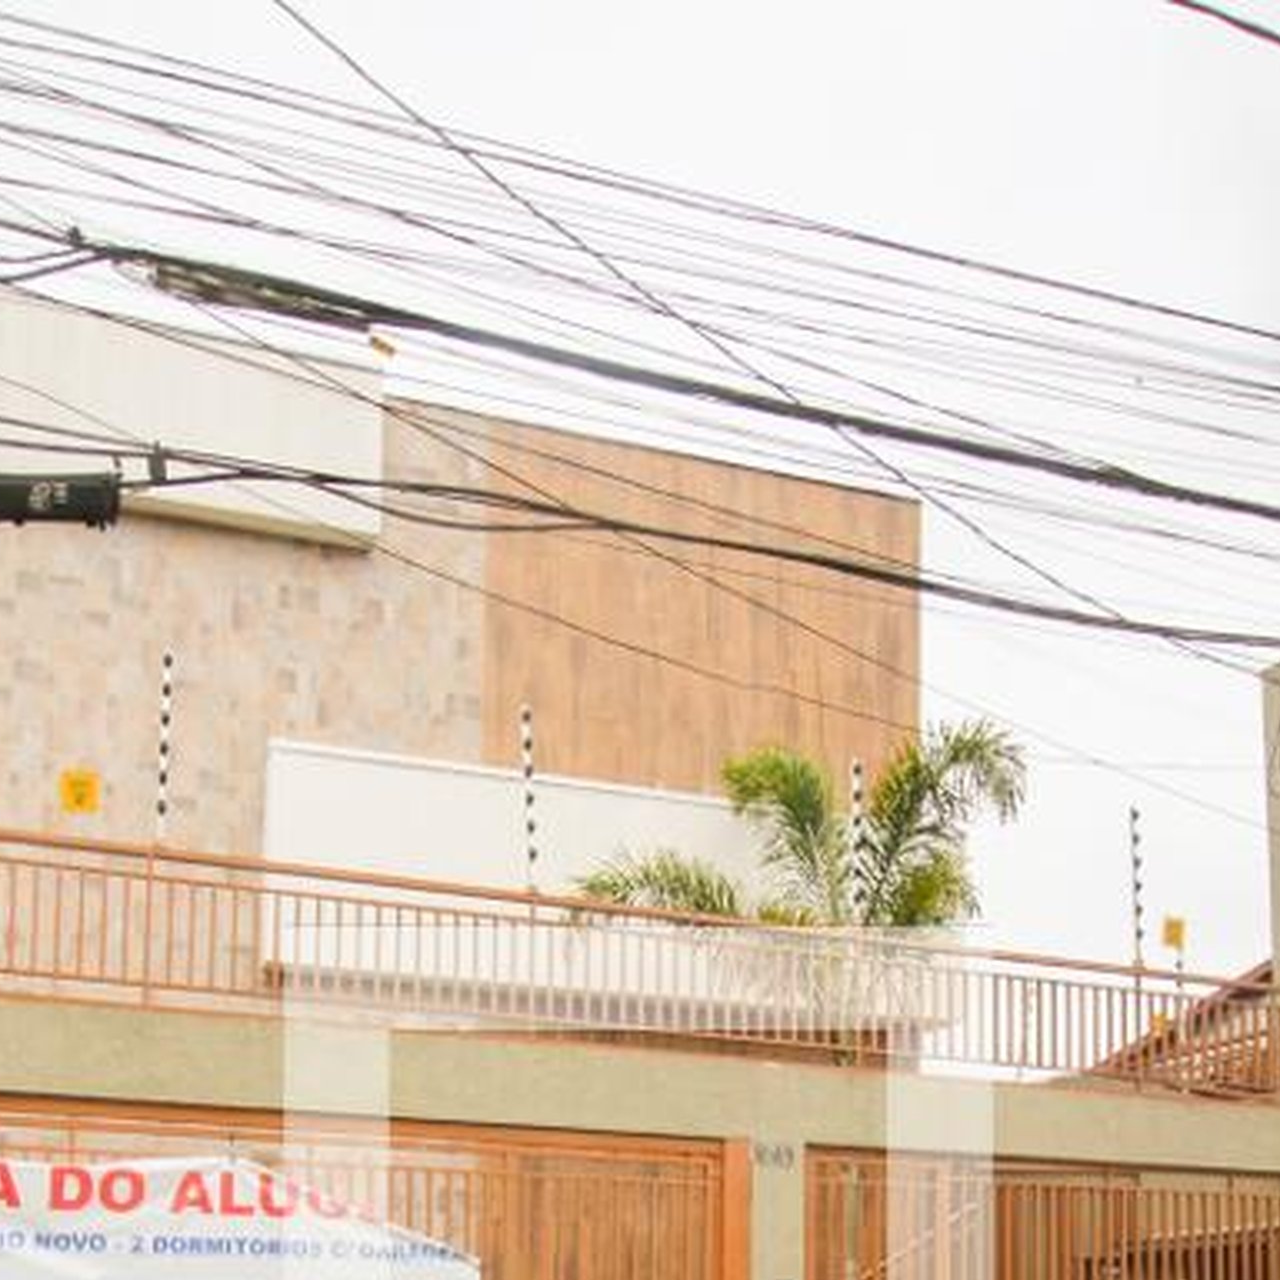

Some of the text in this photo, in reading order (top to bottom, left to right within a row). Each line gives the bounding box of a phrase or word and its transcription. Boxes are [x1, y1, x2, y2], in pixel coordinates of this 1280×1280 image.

[50, 1167, 145, 1211] DO
[36, 1232, 106, 1252] NOVO
[130, 1235, 143, 1253] 2
